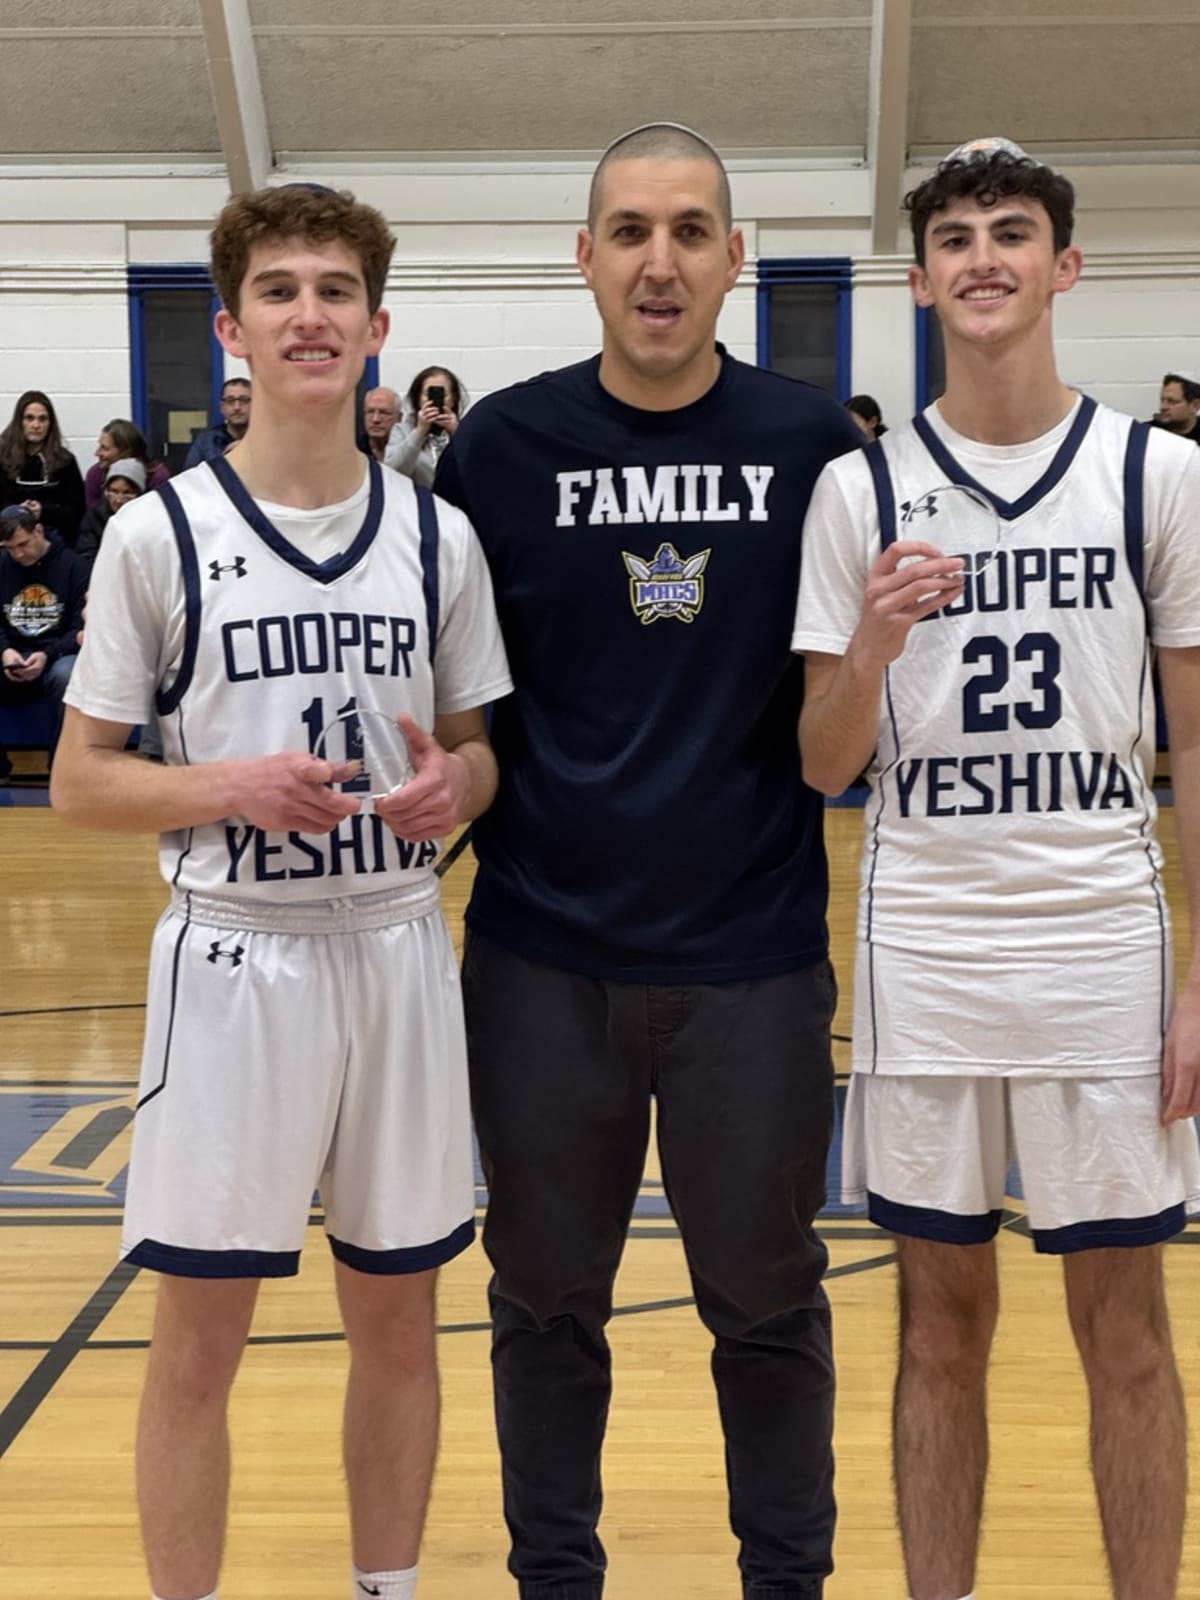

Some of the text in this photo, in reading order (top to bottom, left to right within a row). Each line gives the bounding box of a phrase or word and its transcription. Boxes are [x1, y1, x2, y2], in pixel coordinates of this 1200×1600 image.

[556, 465, 774, 527] FAMILY
[914, 547, 1116, 623] OOPER
[222, 612, 416, 683] COOPER
[962, 632, 1062, 734] 23
[301, 697, 371, 793] 11
[897, 752, 1135, 818] YESHIVA
